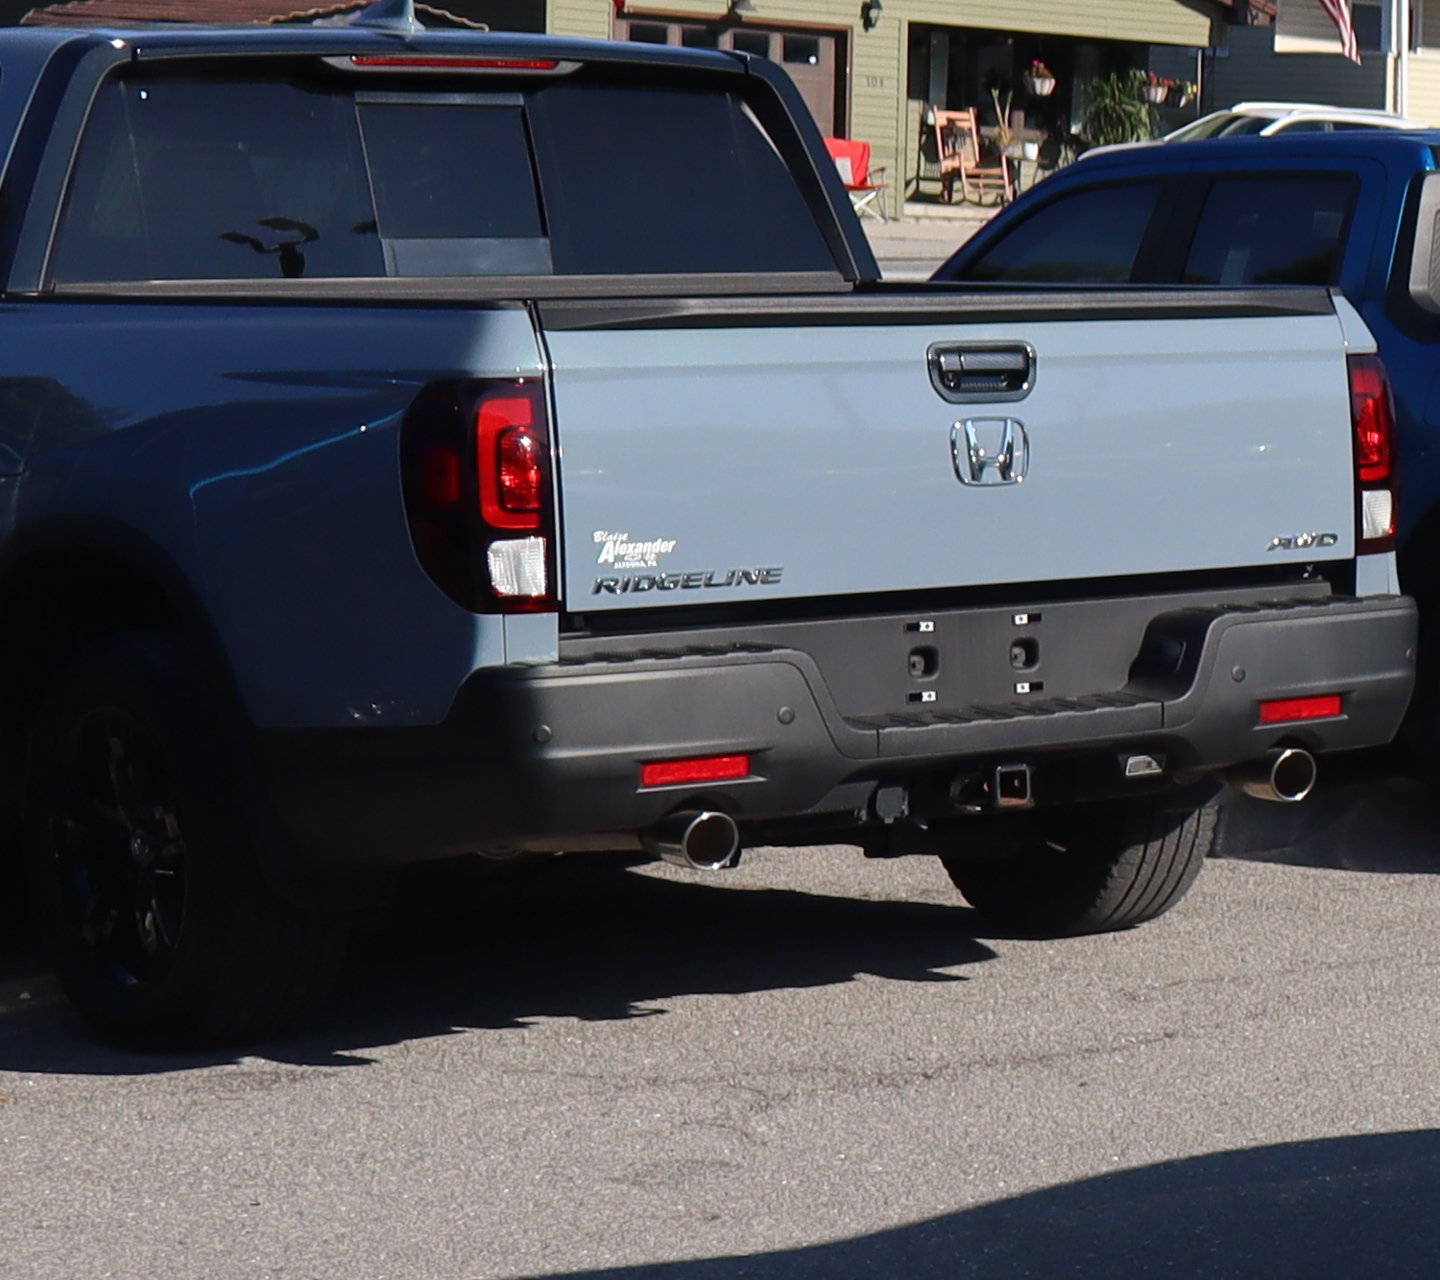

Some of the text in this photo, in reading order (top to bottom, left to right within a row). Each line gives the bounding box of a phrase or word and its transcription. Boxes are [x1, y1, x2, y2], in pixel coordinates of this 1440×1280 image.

[597, 538, 677, 564] Alexander
[1264, 532, 1339, 552] AWD
[591, 567, 785, 596] RIDGELINE
